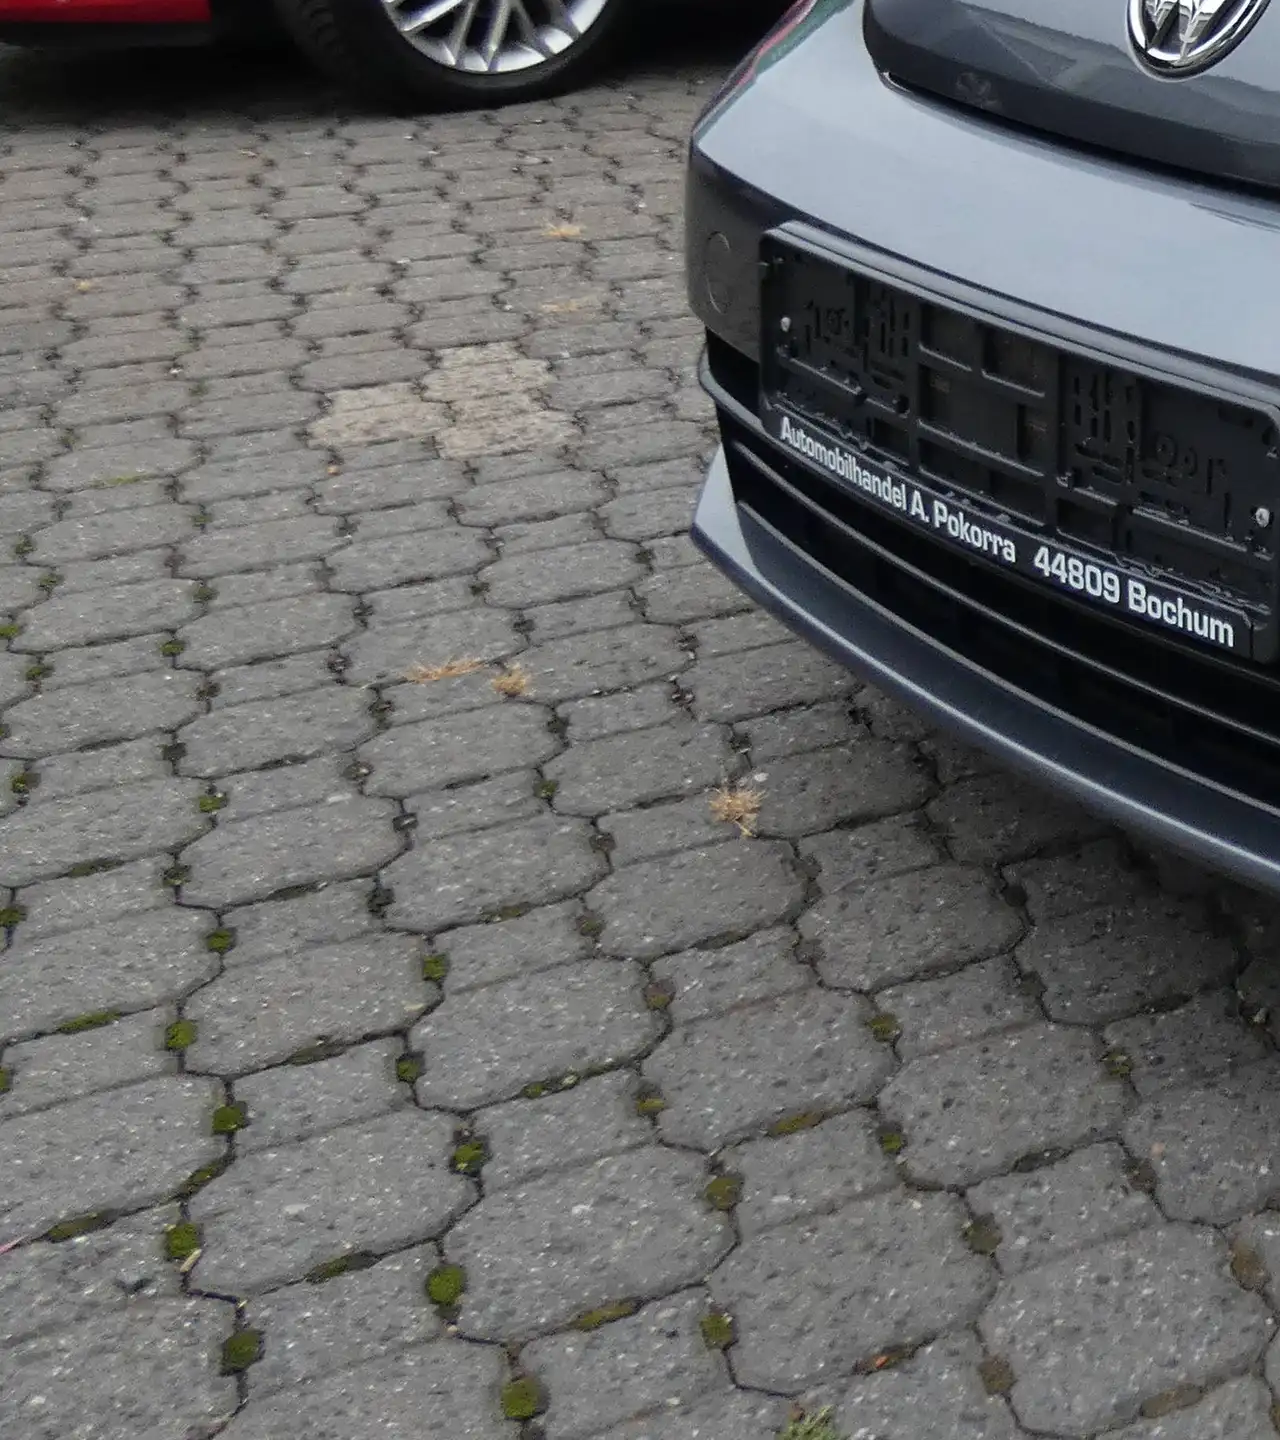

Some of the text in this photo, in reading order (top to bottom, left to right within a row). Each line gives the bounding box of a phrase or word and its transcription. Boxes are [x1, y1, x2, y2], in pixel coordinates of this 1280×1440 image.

[780, 416, 1234, 648] Automobilhandel A. Pokorra 44809 Bochum
